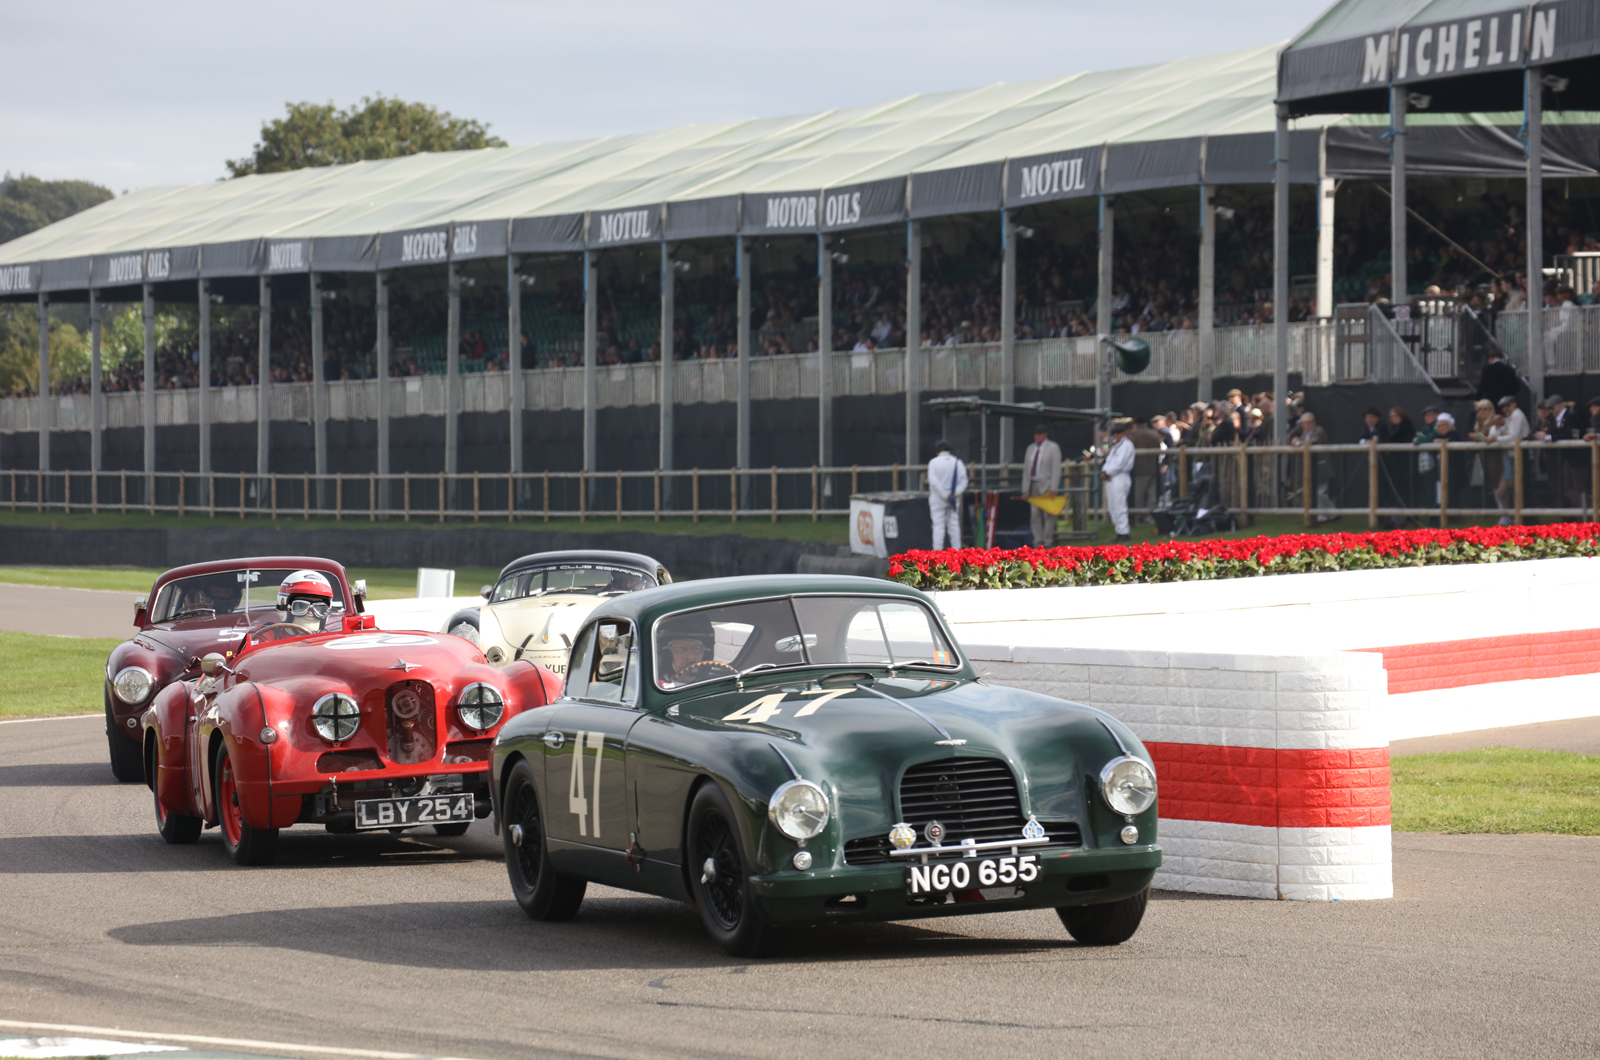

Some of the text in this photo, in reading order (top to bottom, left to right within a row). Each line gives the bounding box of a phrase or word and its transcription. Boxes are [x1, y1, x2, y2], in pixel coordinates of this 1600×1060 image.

[1362, 9, 1556, 83] MICHELIN
[1020, 157, 1086, 198] MOTUL
[599, 210, 650, 242] MOTUL
[766, 192, 861, 228] MOTOR OILS
[269, 243, 303, 270] MOTUL
[401, 224, 478, 261] MOTOR OILS
[0, 265, 31, 291] MOTUL
[108, 252, 170, 282] MOTOR OILS
[721, 688, 858, 723] 47
[569, 731, 605, 838] 47
[361, 797, 468, 825] LBY 254
[911, 855, 1037, 893] NGO 655
